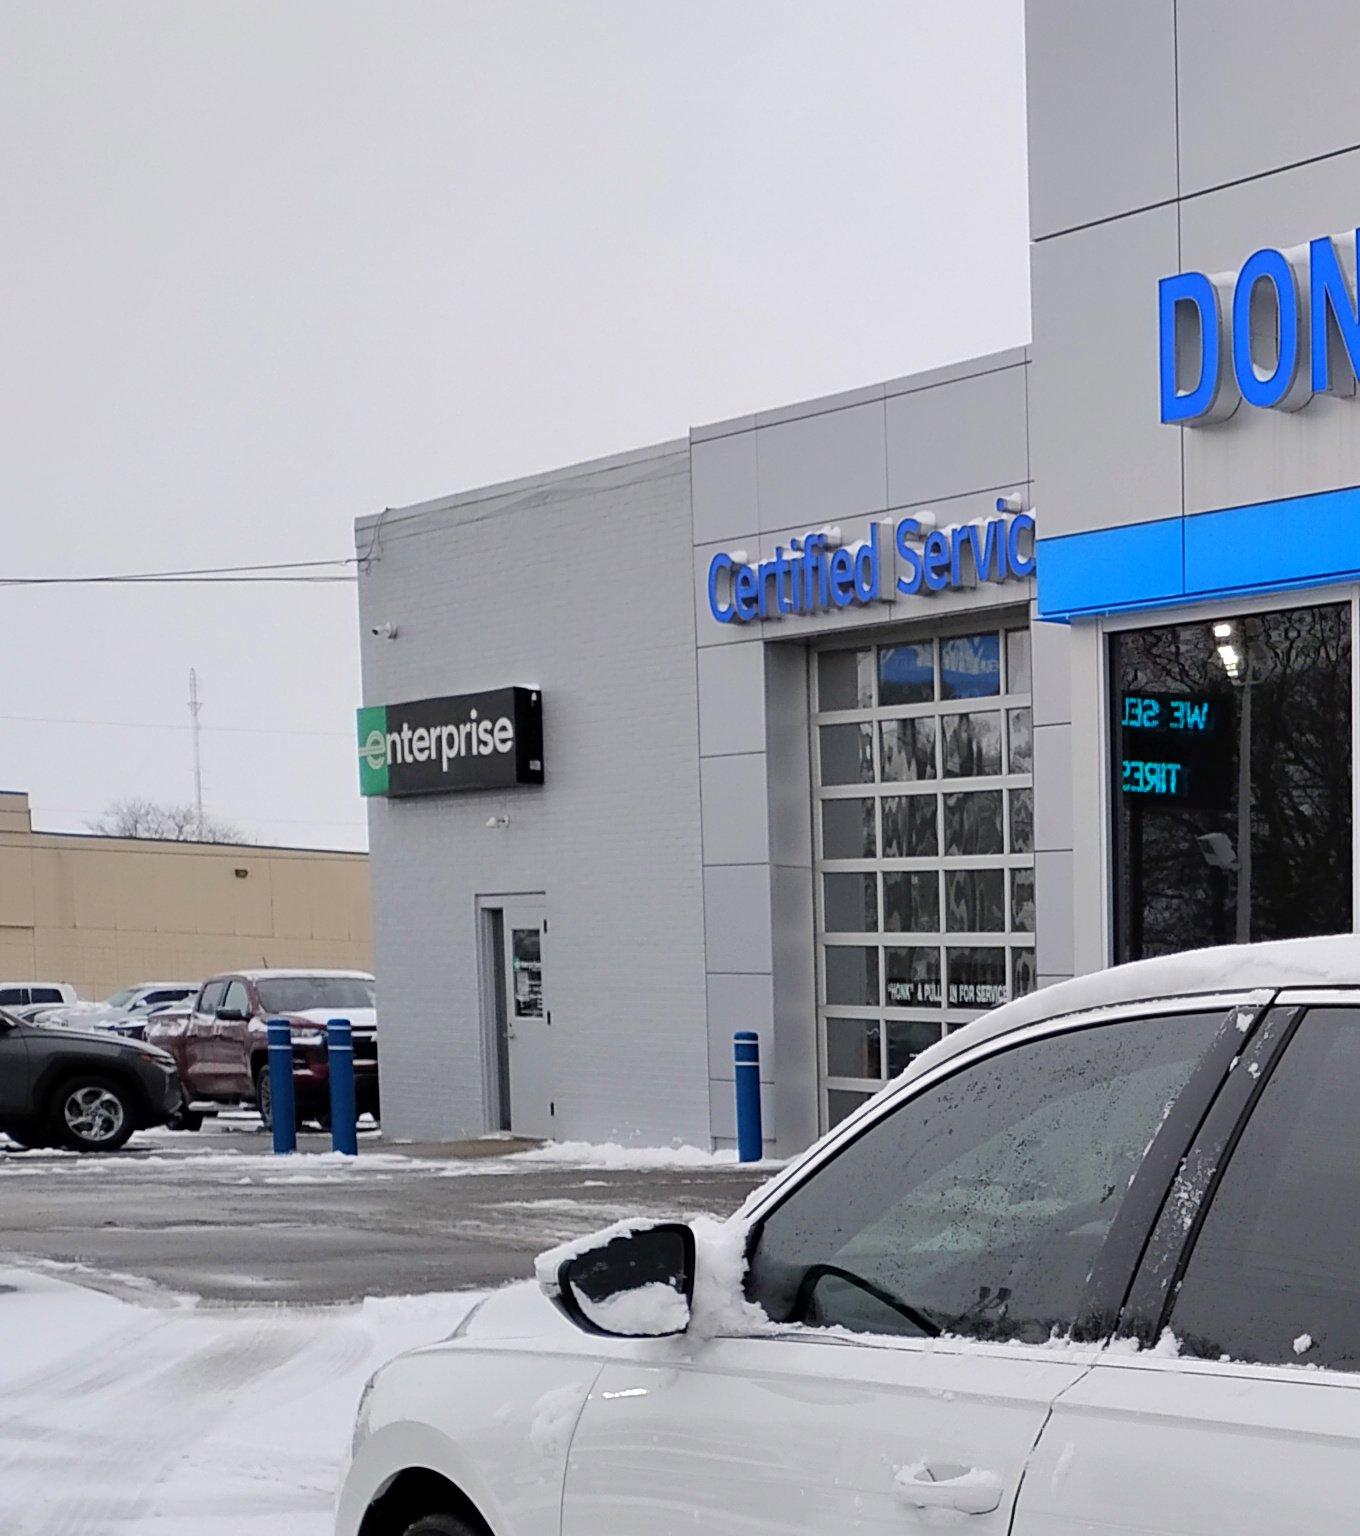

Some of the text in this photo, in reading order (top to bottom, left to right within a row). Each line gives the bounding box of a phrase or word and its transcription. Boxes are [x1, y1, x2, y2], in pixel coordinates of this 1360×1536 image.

[708, 521, 879, 624] Certified
[358, 708, 514, 772] enterprise
[959, 984, 975, 1002] FOR
